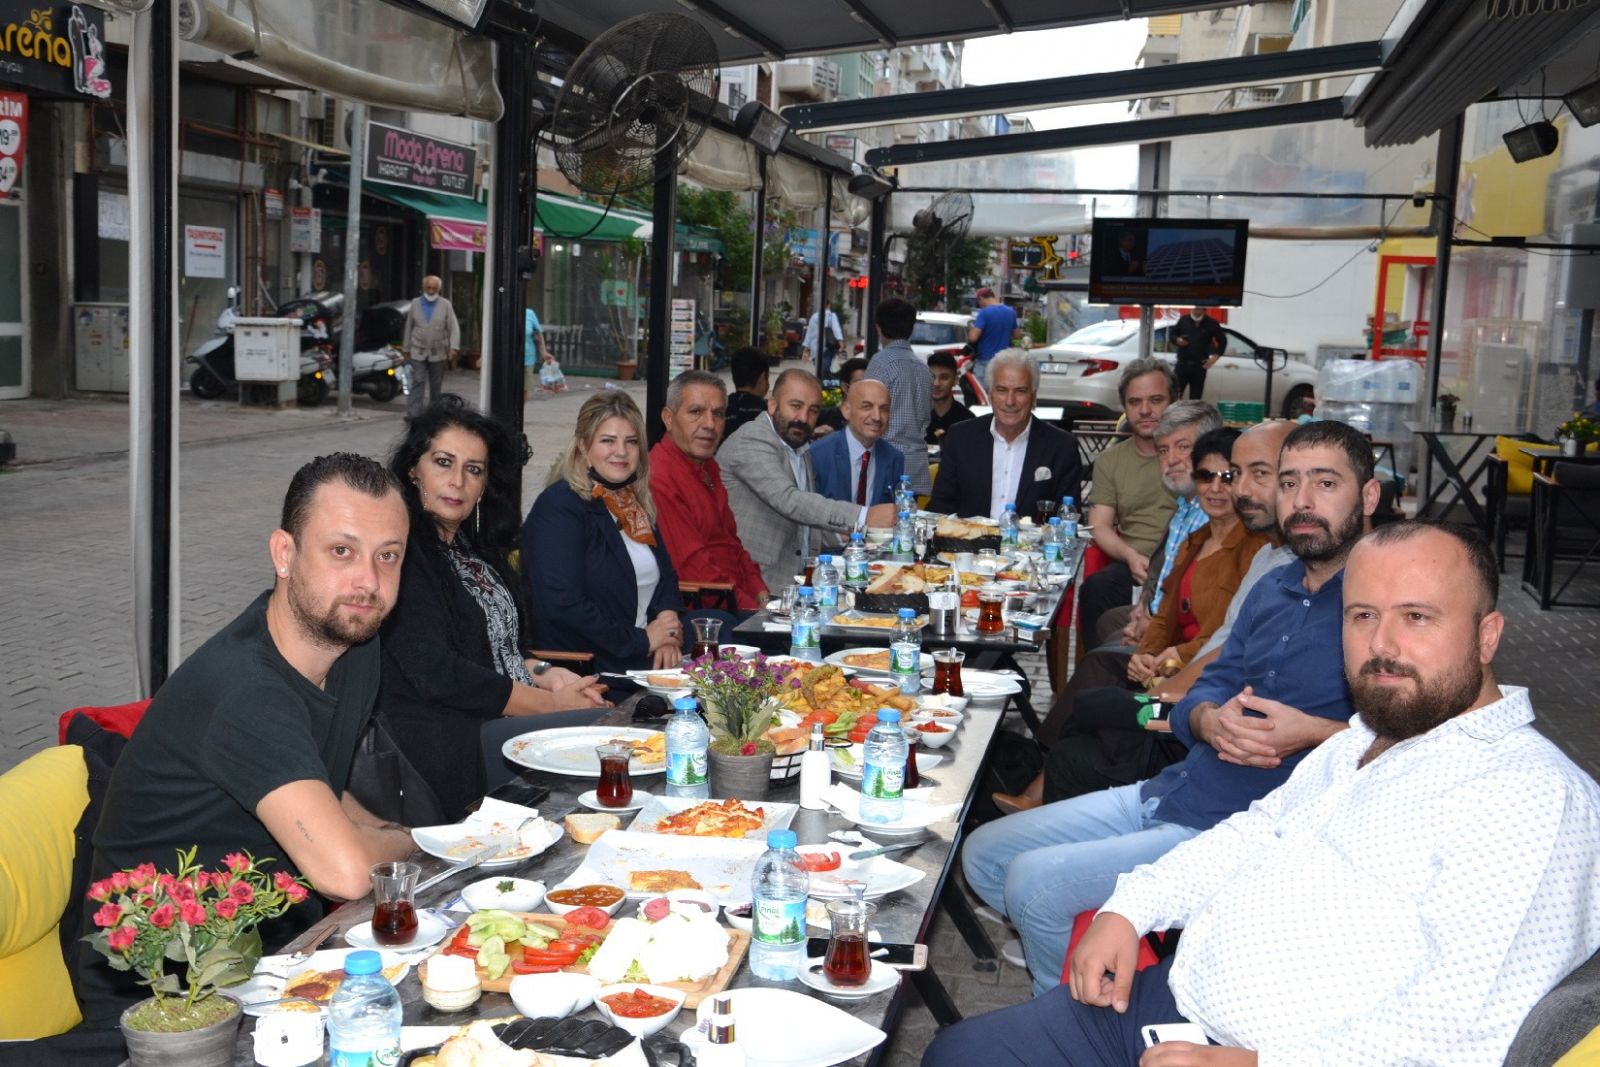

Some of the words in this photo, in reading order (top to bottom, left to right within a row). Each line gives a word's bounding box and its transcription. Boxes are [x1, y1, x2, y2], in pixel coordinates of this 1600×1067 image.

[0, 23, 71, 67] rena
[385, 131, 422, 163] Moda
[426, 141, 464, 171] Arena
[442, 175, 466, 188] OUTLET
